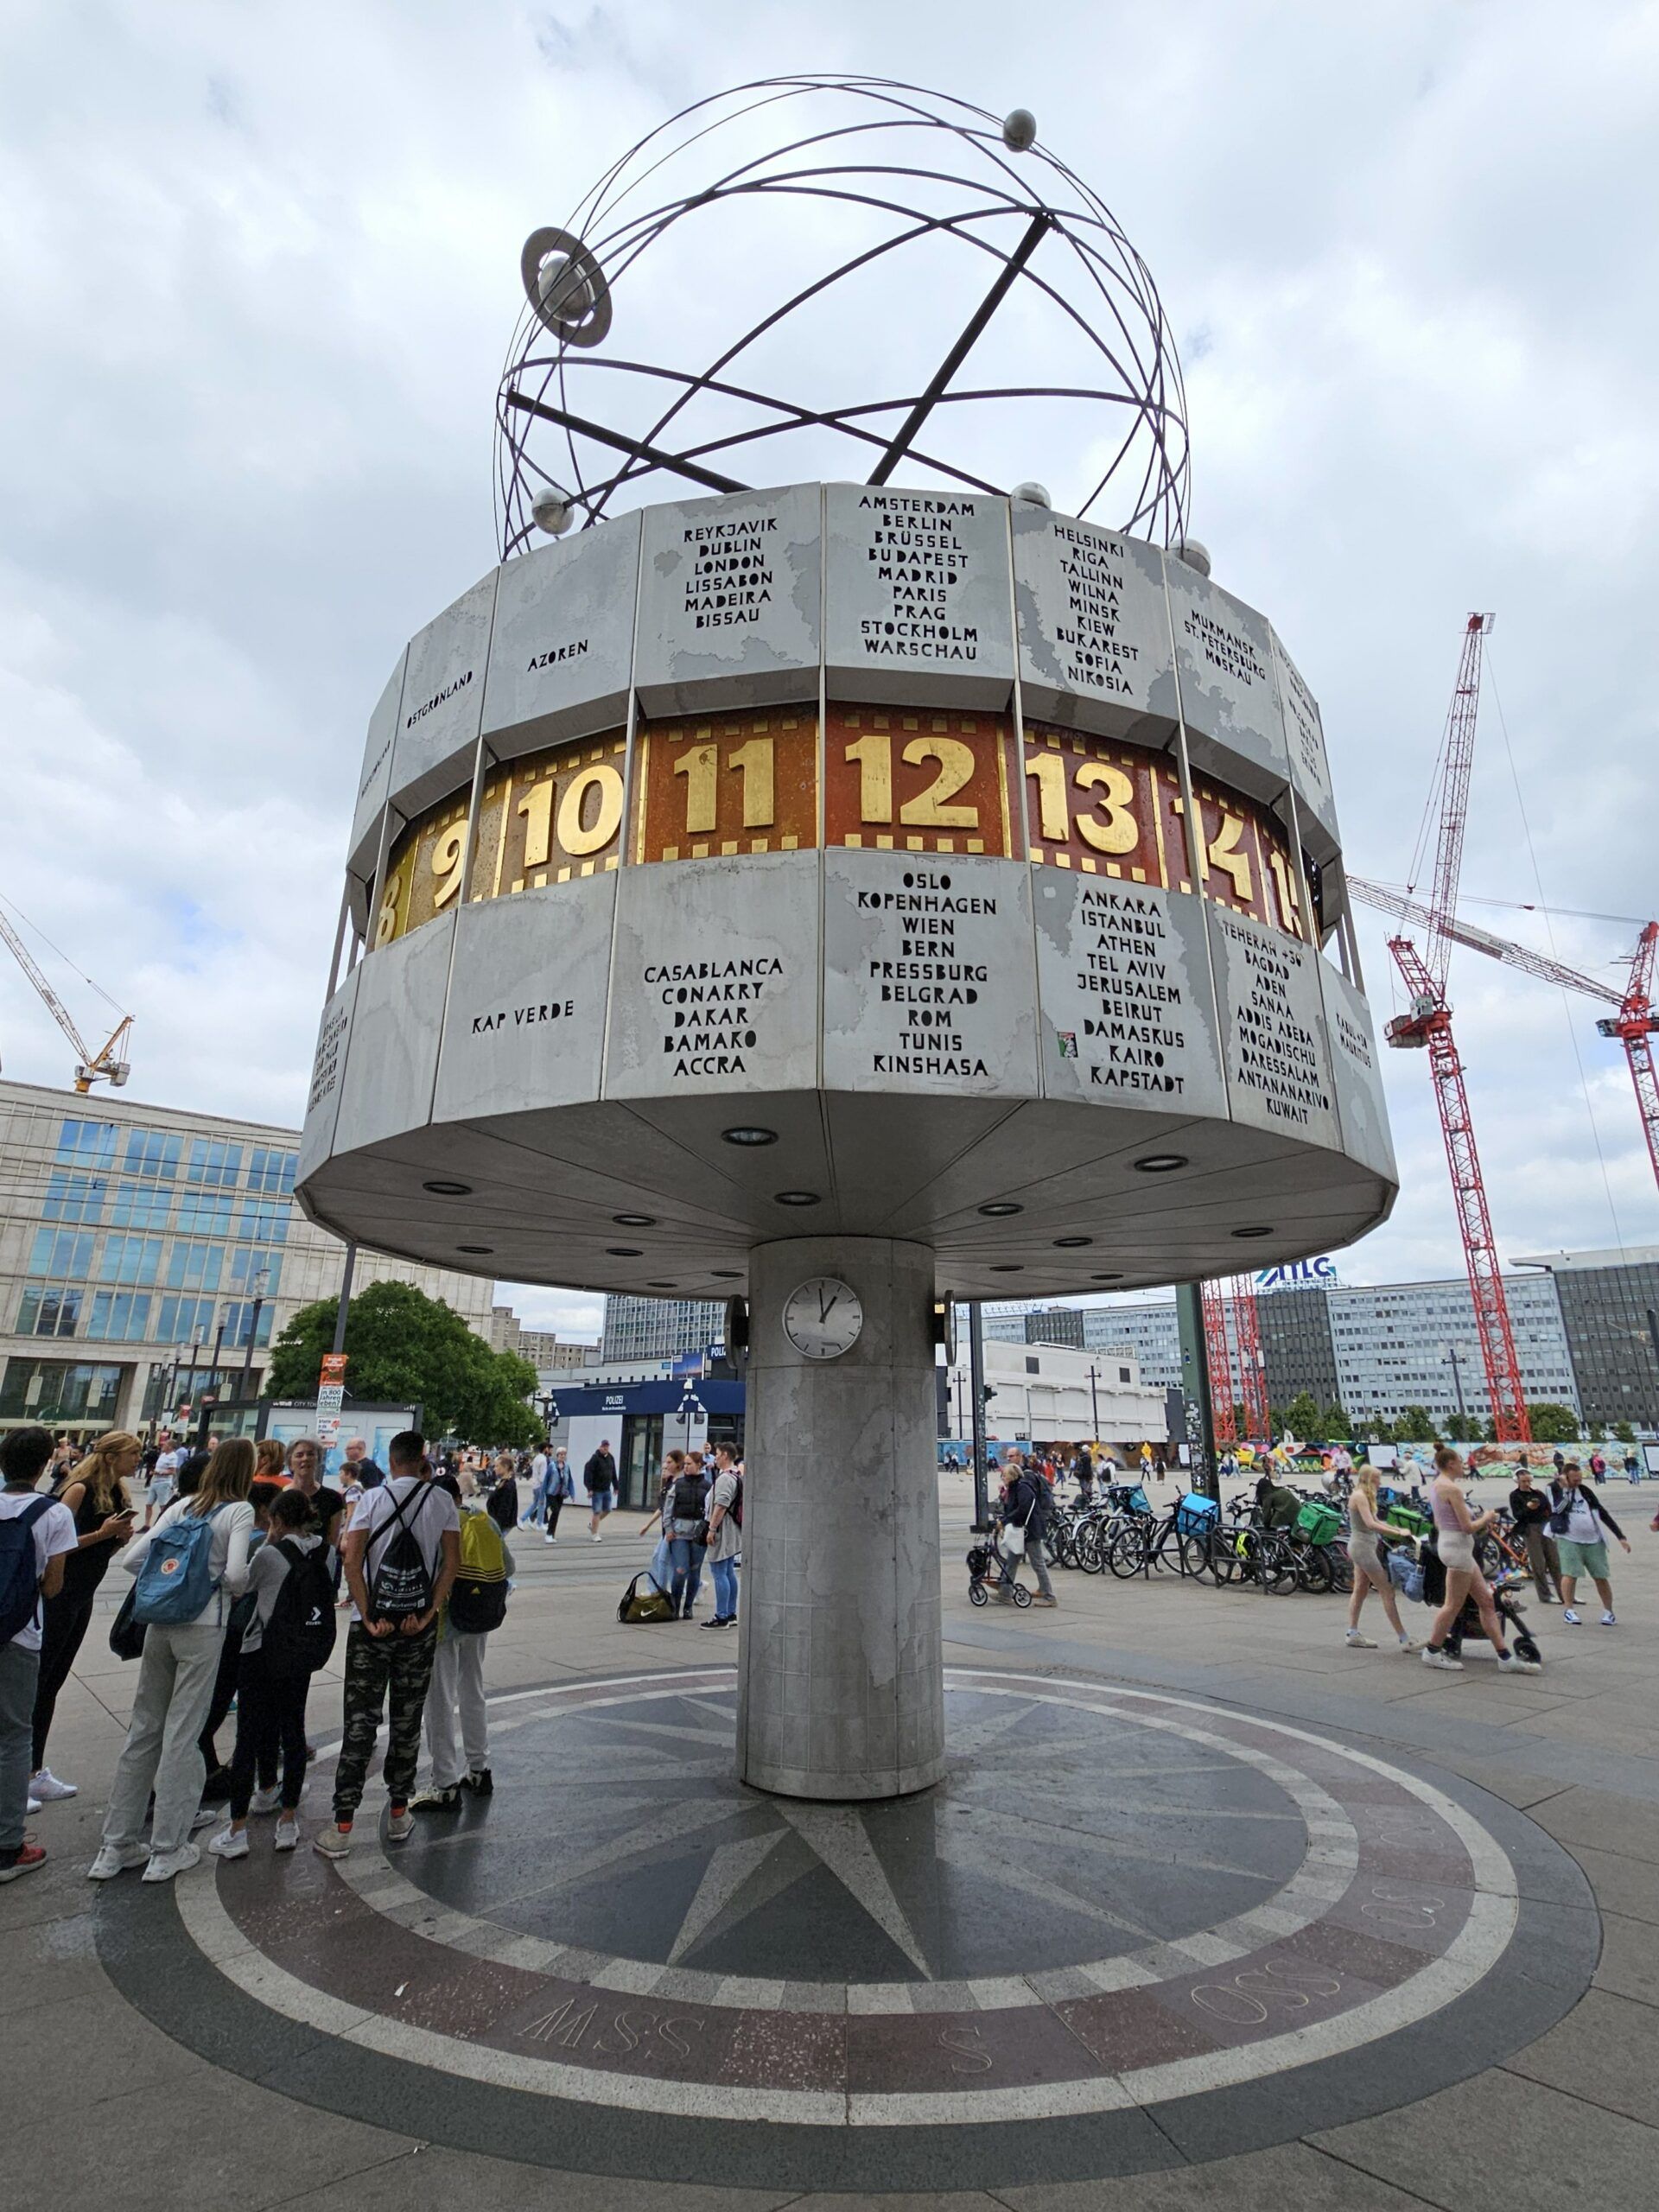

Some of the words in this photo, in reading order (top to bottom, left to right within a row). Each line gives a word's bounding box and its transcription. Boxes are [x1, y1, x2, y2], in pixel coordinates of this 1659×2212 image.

[859, 496, 974, 516] AMSTERDAM
[684, 518, 778, 543] REYKJAVIK
[883, 514, 951, 531] BERLIN
[699, 537, 761, 557] DUBLIN
[875, 531, 962, 550] BRÜSSEL
[1054, 525, 1123, 557] HELSINKI
[695, 554, 764, 575] LONDON
[868, 548, 968, 568] BUDAPEST
[1072, 547, 1109, 569] RIGA
[686, 571, 772, 594] LISSABON
[879, 567, 957, 584] MADRID
[1060, 560, 1122, 589] TALLINN
[685, 589, 772, 612] MADEIRA
[893, 586, 946, 602] PARIS
[1068, 579, 1119, 605] WILNA
[696, 608, 760, 628] BISSAU
[894, 604, 945, 620] PRAG
[1070, 596, 1121, 622] MINSK
[861, 620, 977, 642] STOCKHOLM
[1077, 615, 1115, 637] KIEW
[1192, 609, 1255, 659] MURMANSK
[527, 639, 588, 671] AZOREN
[865, 639, 976, 660] WARSCHAU
[1057, 626, 1138, 660] BUKAREST
[1076, 651, 1122, 675] SOFIA
[1205, 648, 1251, 685] MOSKAU
[1068, 665, 1133, 695] NIKOSIA
[674, 738, 774, 834] 11
[845, 735, 978, 830] 12
[1027, 752, 1139, 855] 13
[518, 764, 624, 868] 10
[1173, 797, 1253, 902] 14
[432, 819, 468, 908] 9
[903, 873, 950, 890] OSLO
[375, 874, 401, 950] 8
[858, 892, 996, 914] KOPENHAGEN
[1083, 890, 1161, 918] ANKARA
[902, 917, 954, 935] WIEN
[1082, 910, 1166, 938] ISTANBUL
[902, 940, 954, 957] BERN
[1097, 934, 1155, 957] ATHEN
[1223, 921, 1276, 957] TEHERAN
[645, 958, 783, 982] CASABLANCA
[870, 962, 987, 982] PRESSBURG
[1087, 953, 1118, 972] TEL
[1127, 960, 1166, 980] AVIV
[1244, 950, 1289, 980] BAGDAD
[663, 982, 763, 1005] CONAKRY
[881, 985, 977, 1004] BELGRAD
[1077, 973, 1181, 1004] JERUSALEM
[1256, 974, 1286, 998] ADEN
[472, 1014, 505, 1033] KAP
[514, 1001, 573, 1025] VERDE
[674, 1007, 748, 1027] DAKAR
[1102, 999, 1161, 1022] BEIRUT
[1251, 991, 1294, 1020] SANAA
[908, 1009, 951, 1027] ROM
[1237, 1006, 1272, 1031] ADDIS
[1279, 1021, 1313, 1047] ABEBA
[664, 1030, 756, 1052] BAMAKO
[899, 1033, 962, 1051] TUNIS
[1084, 1019, 1184, 1048] DAMASKUS
[1109, 1045, 1164, 1067] KAIRO
[1240, 1027, 1315, 1066] MOGADISCHU
[673, 1056, 746, 1077] ACCRA
[874, 1055, 988, 1076] KINSHASA
[1242, 1047, 1319, 1088] DARESSALAM
[1091, 1065, 1184, 1094] KAPSTADT
[1238, 1068, 1328, 1110] ANTANANARIVO
[1266, 1097, 1307, 1124] KUWAIT
[938, 2025, 994, 2075] S
